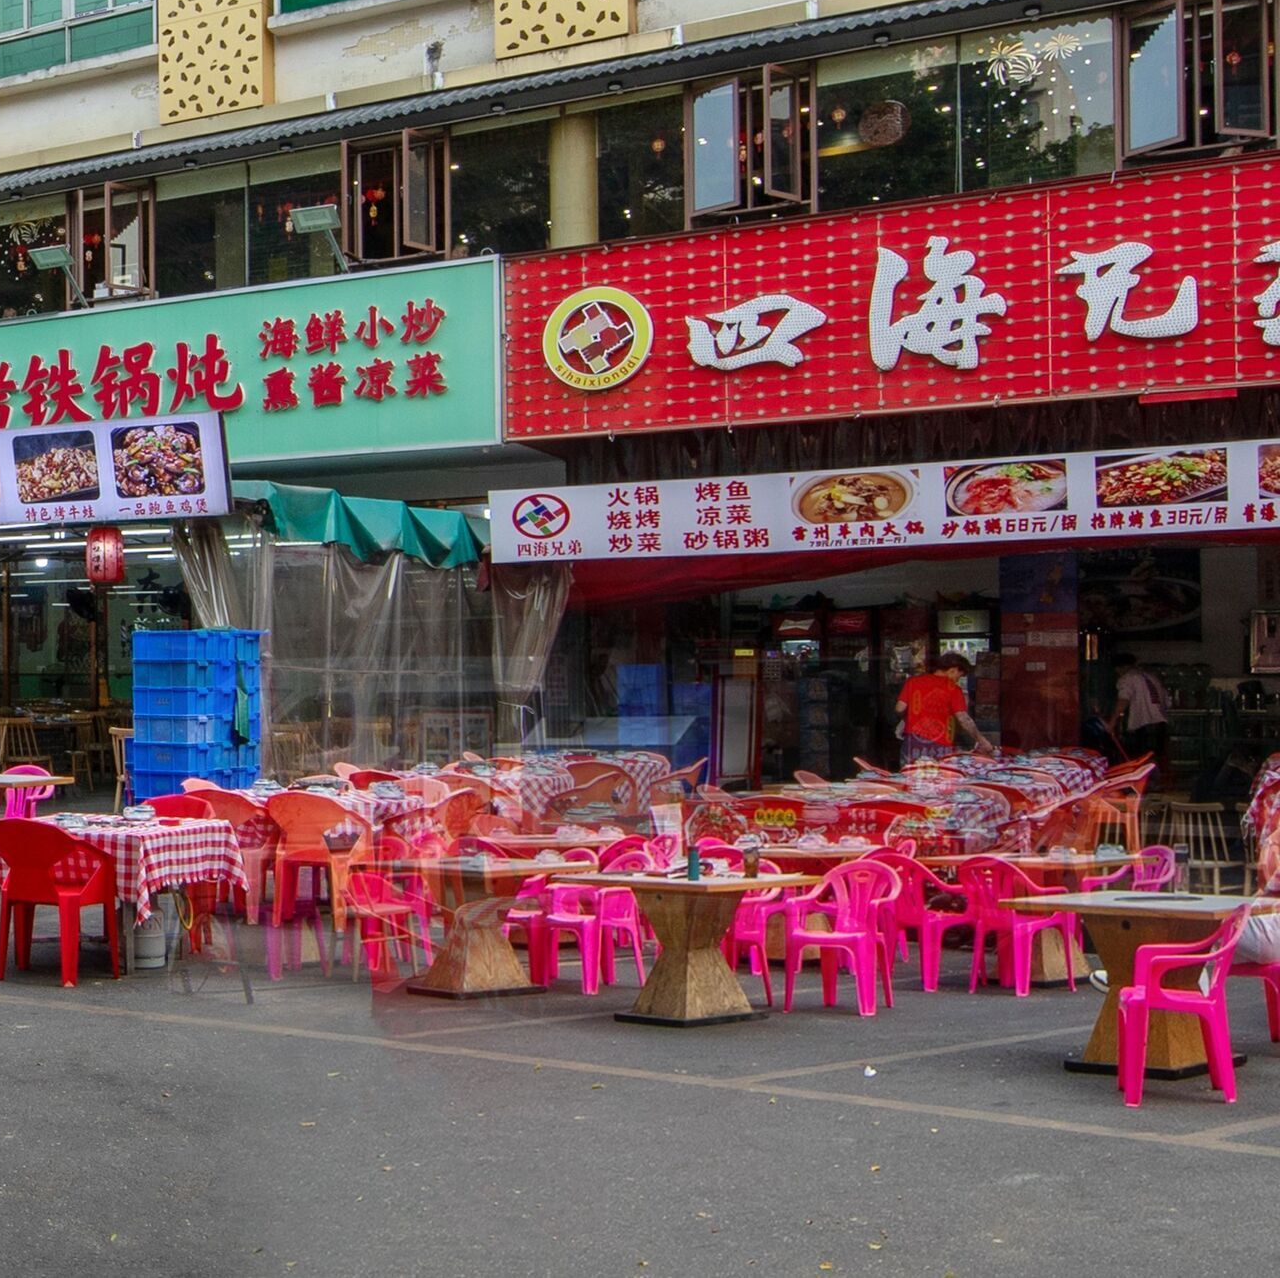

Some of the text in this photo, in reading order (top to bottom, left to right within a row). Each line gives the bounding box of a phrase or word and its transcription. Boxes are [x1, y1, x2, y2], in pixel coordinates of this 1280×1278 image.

[685, 235, 1280, 372] 四海兄
[258, 297, 447, 361] 海鲜小炒
[262, 351, 449, 413] 熏酱凉菜
[606, 485, 661, 508] 火锅
[694, 480, 752, 503] 烤鱼
[25, 505, 96, 521] 特色烤牛蛙
[118, 497, 209, 516] 一品鲍鱼鸡煲
[695, 504, 753, 527] 凉菜
[1090, 505, 1229, 531] 招牌烤鱼38元/条
[606, 508, 662, 530] 烧烤
[792, 520, 925, 541] 雷州羊肉火锅
[940, 513, 1078, 539] 砂锅粥68元/锅
[516, 537, 584, 558] 四海兄弟
[607, 531, 662, 553] 炒菜
[682, 527, 770, 551] 砂锅粥
